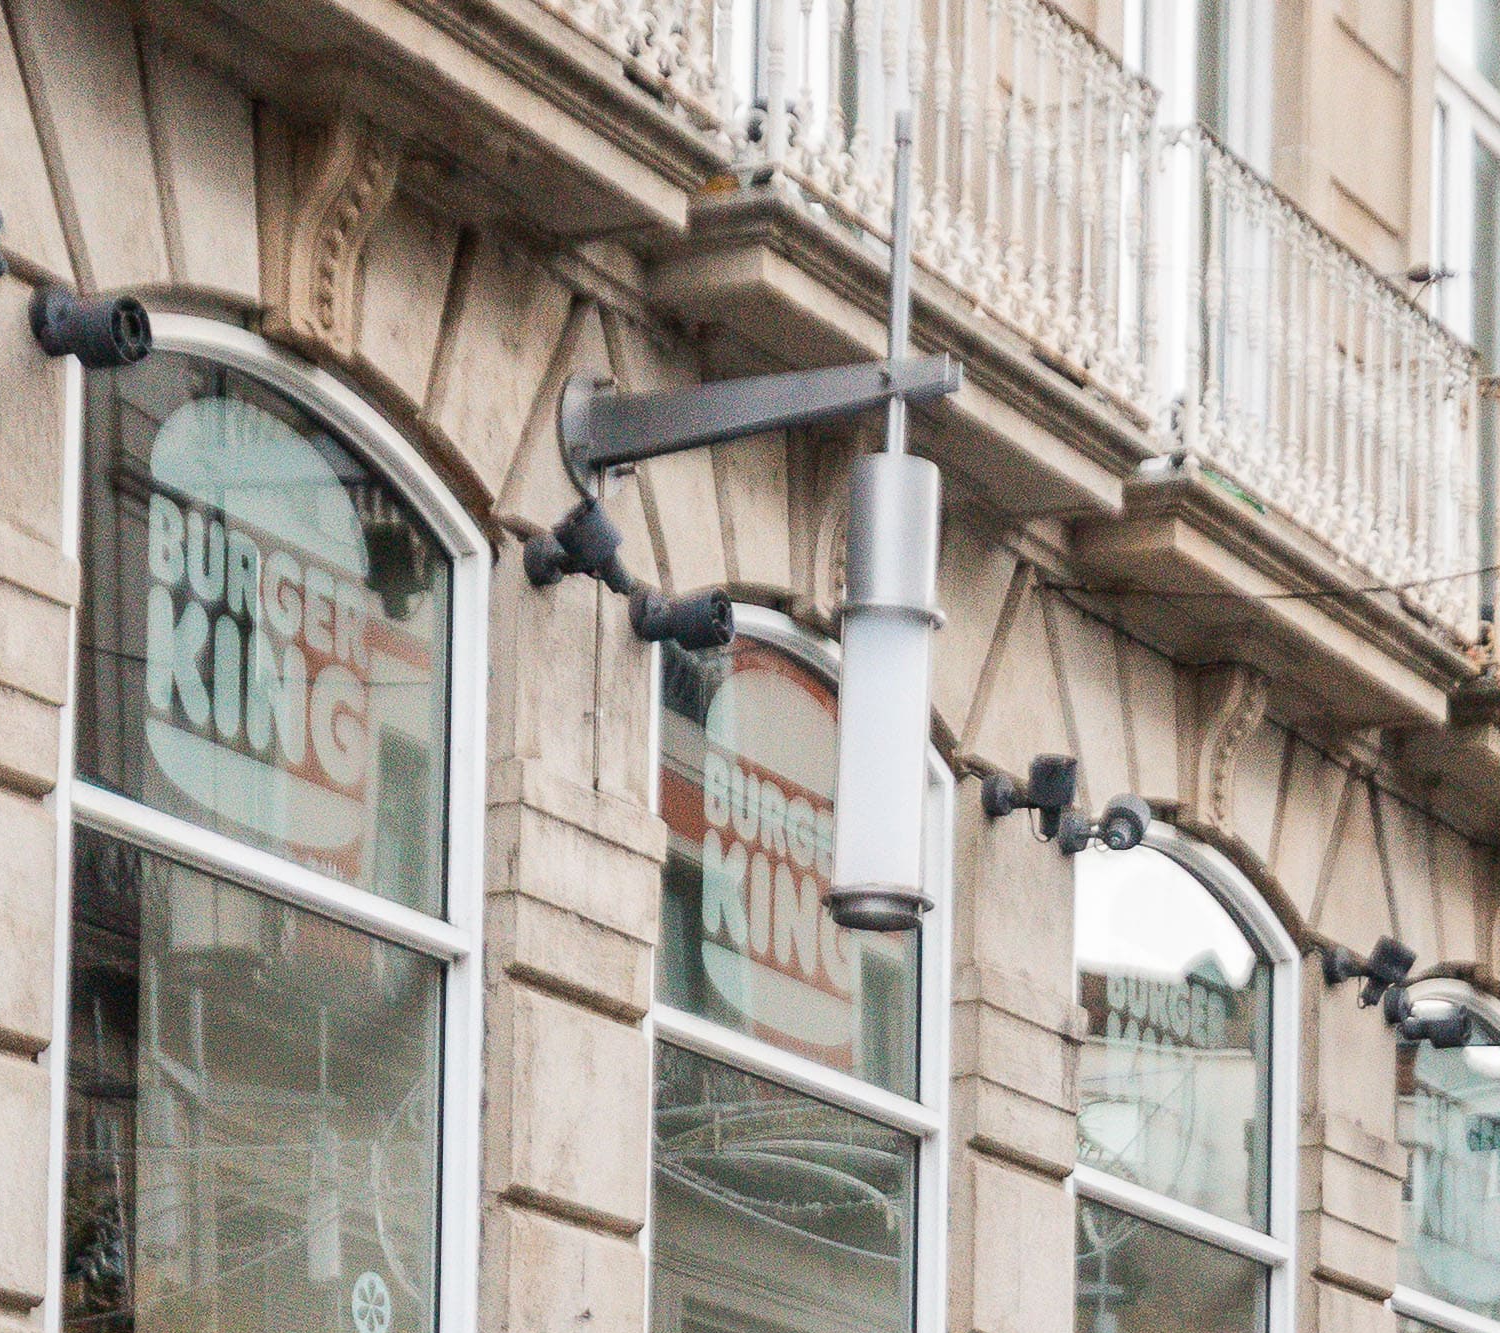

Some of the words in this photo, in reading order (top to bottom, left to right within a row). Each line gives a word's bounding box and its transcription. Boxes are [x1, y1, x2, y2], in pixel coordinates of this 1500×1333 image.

[148, 493, 370, 674] BURGER
[146, 582, 371, 788] KING
[704, 752, 833, 880] BURGE
